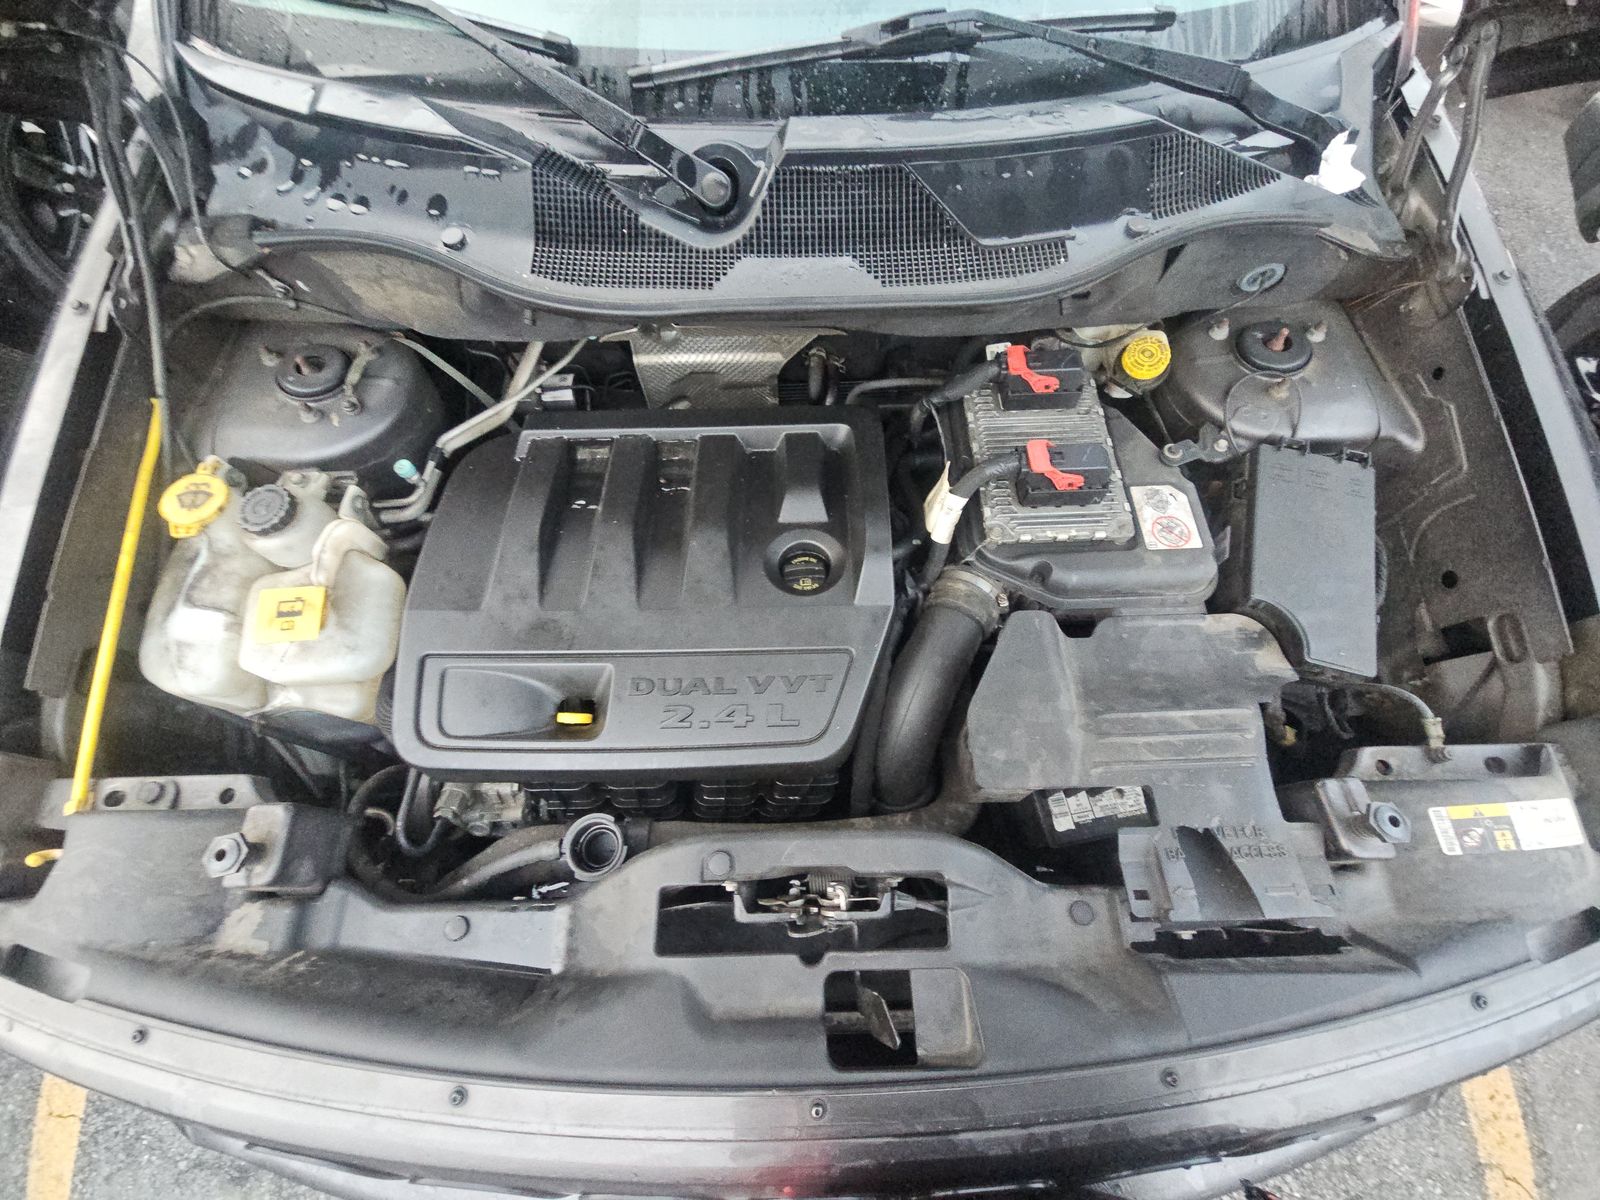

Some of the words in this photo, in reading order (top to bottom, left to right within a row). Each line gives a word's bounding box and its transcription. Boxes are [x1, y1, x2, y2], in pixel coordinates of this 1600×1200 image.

[629, 676, 738, 697] DUAL
[746, 674, 834, 695] VVT
[1229, 844, 1288, 860] ACCESS
